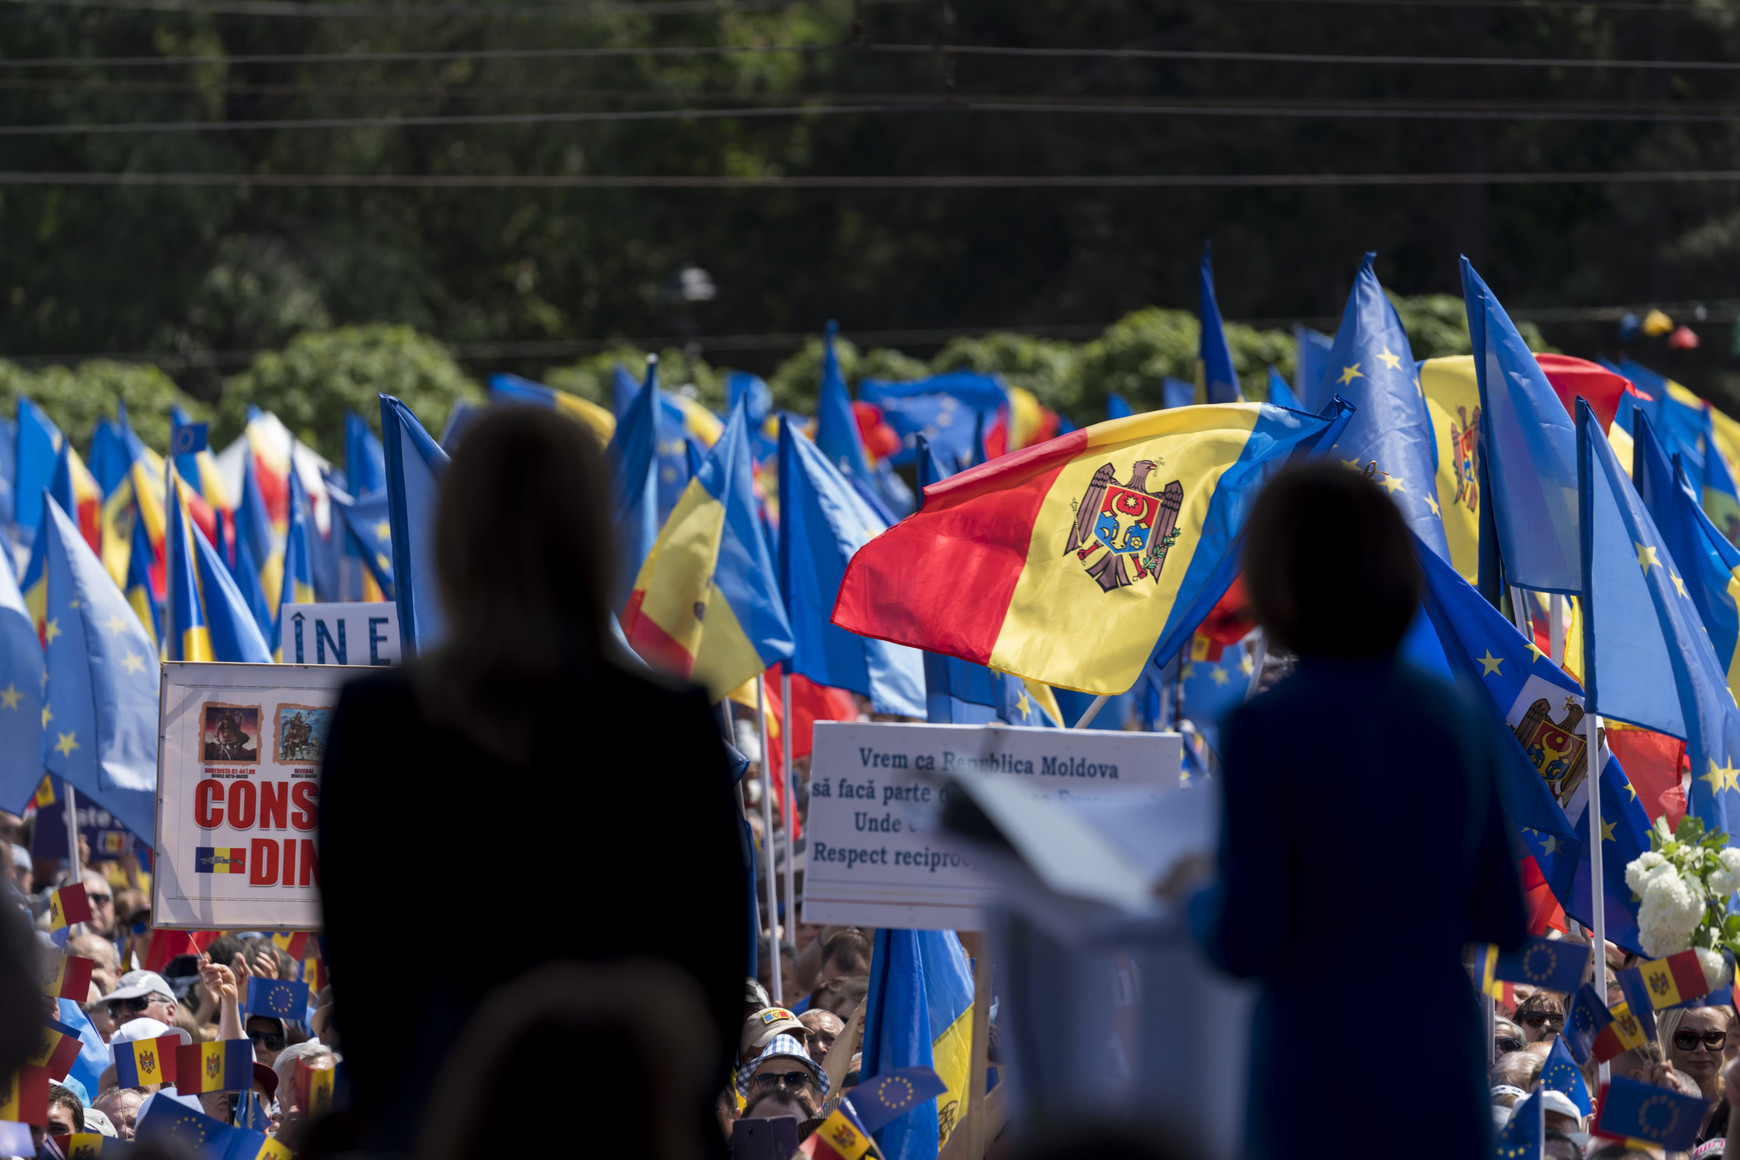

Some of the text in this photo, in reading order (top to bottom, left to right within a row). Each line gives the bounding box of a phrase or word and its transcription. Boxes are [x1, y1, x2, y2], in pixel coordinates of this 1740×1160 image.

[290, 611, 348, 665] ÎN
[858, 747, 908, 770] Vrem
[915, 754, 935, 771] ca
[1041, 756, 1119, 779] Moldova
[811, 778, 831, 798] să
[838, 780, 876, 800] facă
[882, 781, 931, 806] parte
[854, 811, 902, 833] Unde
[812, 842, 888, 869] Respect
